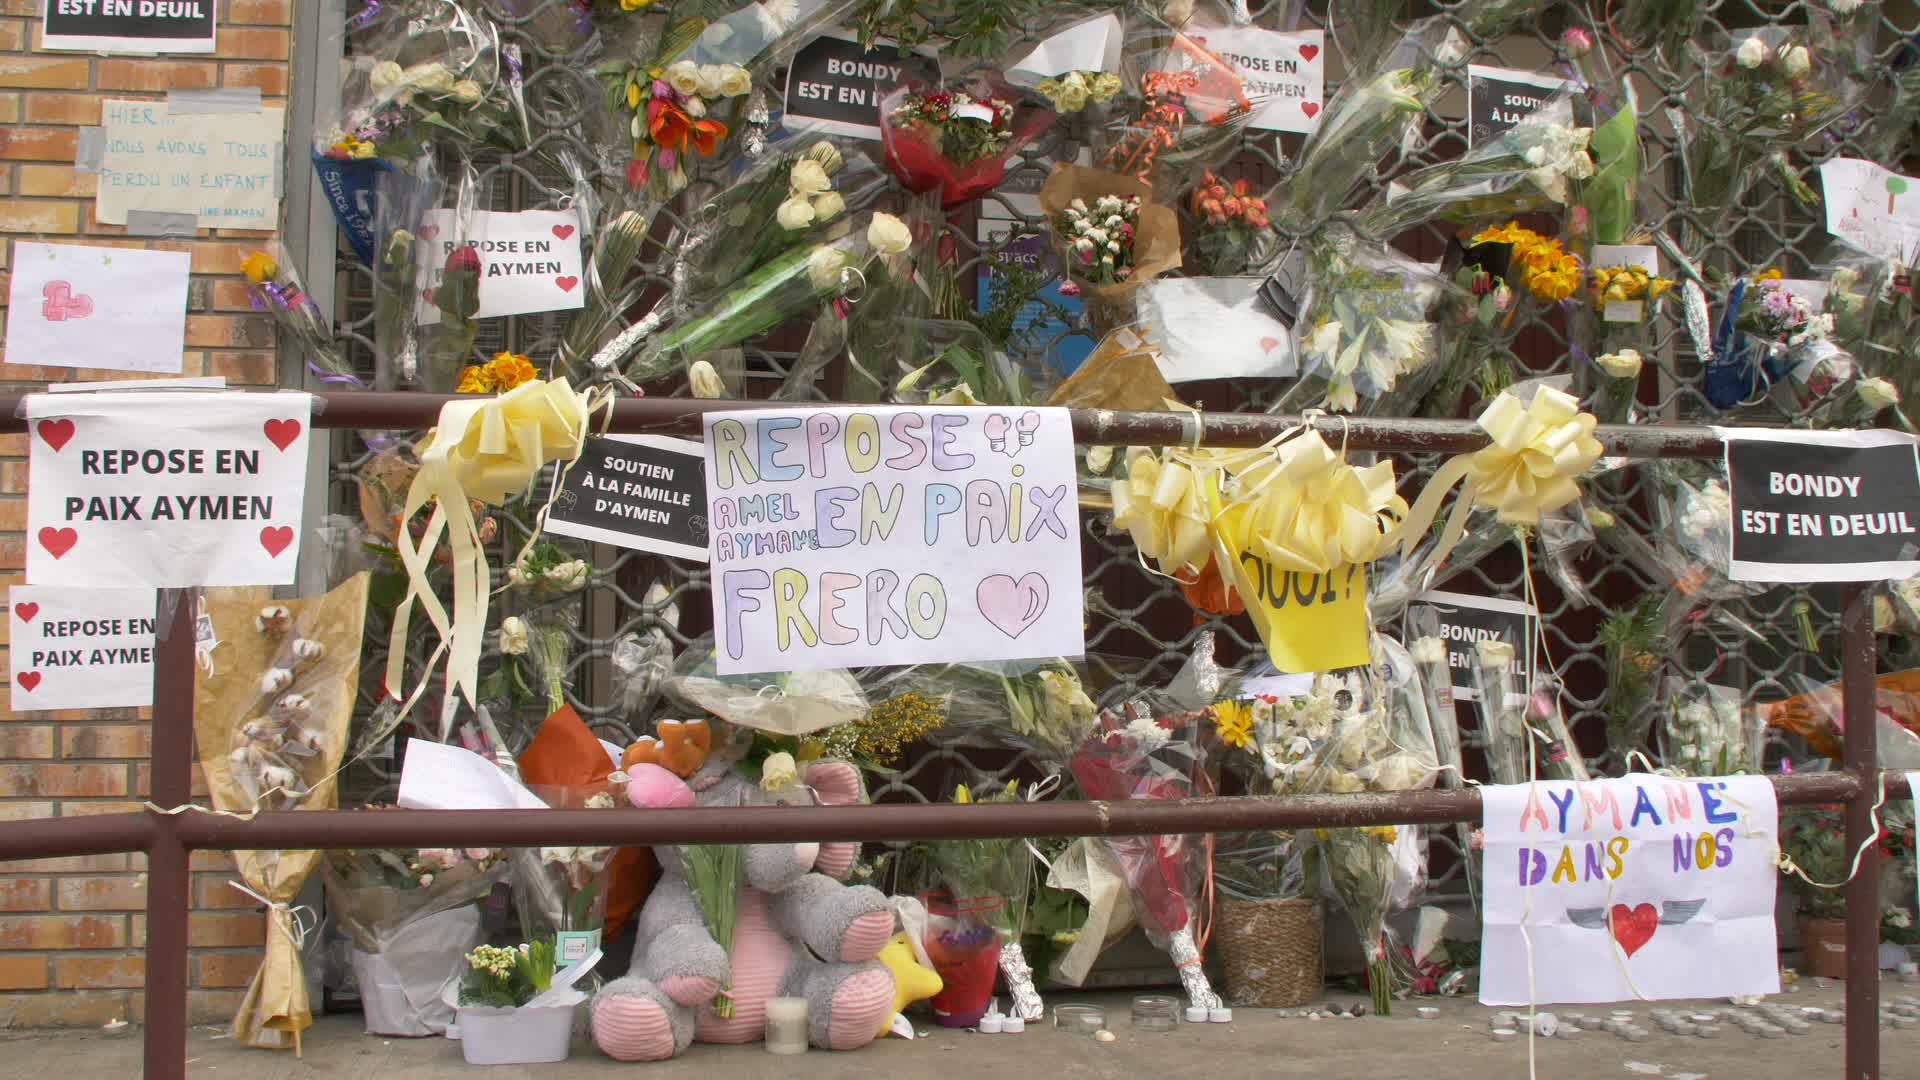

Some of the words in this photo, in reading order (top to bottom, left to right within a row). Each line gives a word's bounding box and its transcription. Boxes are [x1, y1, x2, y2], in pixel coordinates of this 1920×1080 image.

[58, 0, 96, 15] EST
[102, 0, 132, 16] EN
[139, 1, 204, 18] DEUIL
[827, 58, 902, 82] BONDY
[1222, 52, 1269, 71] POSE
[1275, 60, 1297, 74] EN
[798, 81, 833, 100] EST
[838, 87, 866, 105] EN
[1491, 107, 1501, 121] À
[1503, 112, 1520, 124] LA
[156, 139, 207, 155] AVONS
[223, 141, 268, 157] TOUS
[101, 168, 160, 186] PERDU
[172, 172, 190, 186] UN
[200, 173, 273, 189] ENFANT
[443, 241, 518, 255] RPOSE
[525, 241, 550, 253] EN
[487, 262, 561, 277] AYMEN
[82, 449, 204, 475] REPOSE
[216, 449, 259, 475] EN
[712, 412, 975, 490] REPOSE
[603, 456, 674, 482] SOUTIEN
[582, 471, 595, 488] À
[598, 477, 619, 494] LA
[623, 482, 692, 507] FAMILLE
[1769, 471, 1862, 497] BONDY
[65, 496, 142, 521] PAIX
[151, 495, 273, 521] AYMEN
[595, 499, 671, 525] D'AYMEN
[713, 492, 800, 530] AMEL
[815, 481, 904, 548] EN
[1741, 509, 1781, 535] EST
[1787, 513, 1823, 536] EN
[1829, 511, 1916, 537] DEUIL
[716, 528, 820, 562] AYMANE
[723, 568, 948, 660] FRERO
[42, 619, 121, 637] REPOSE
[129, 619, 155, 635] EN
[1440, 624, 1500, 643] BONDY
[32, 650, 83, 667] PAIX
[89, 648, 155, 666] AYME
[1449, 651, 1470, 669] EN
[1519, 782, 1738, 834] AYMANE
[1518, 836, 1629, 886] DANS
[1673, 828, 1734, 873] NOS
